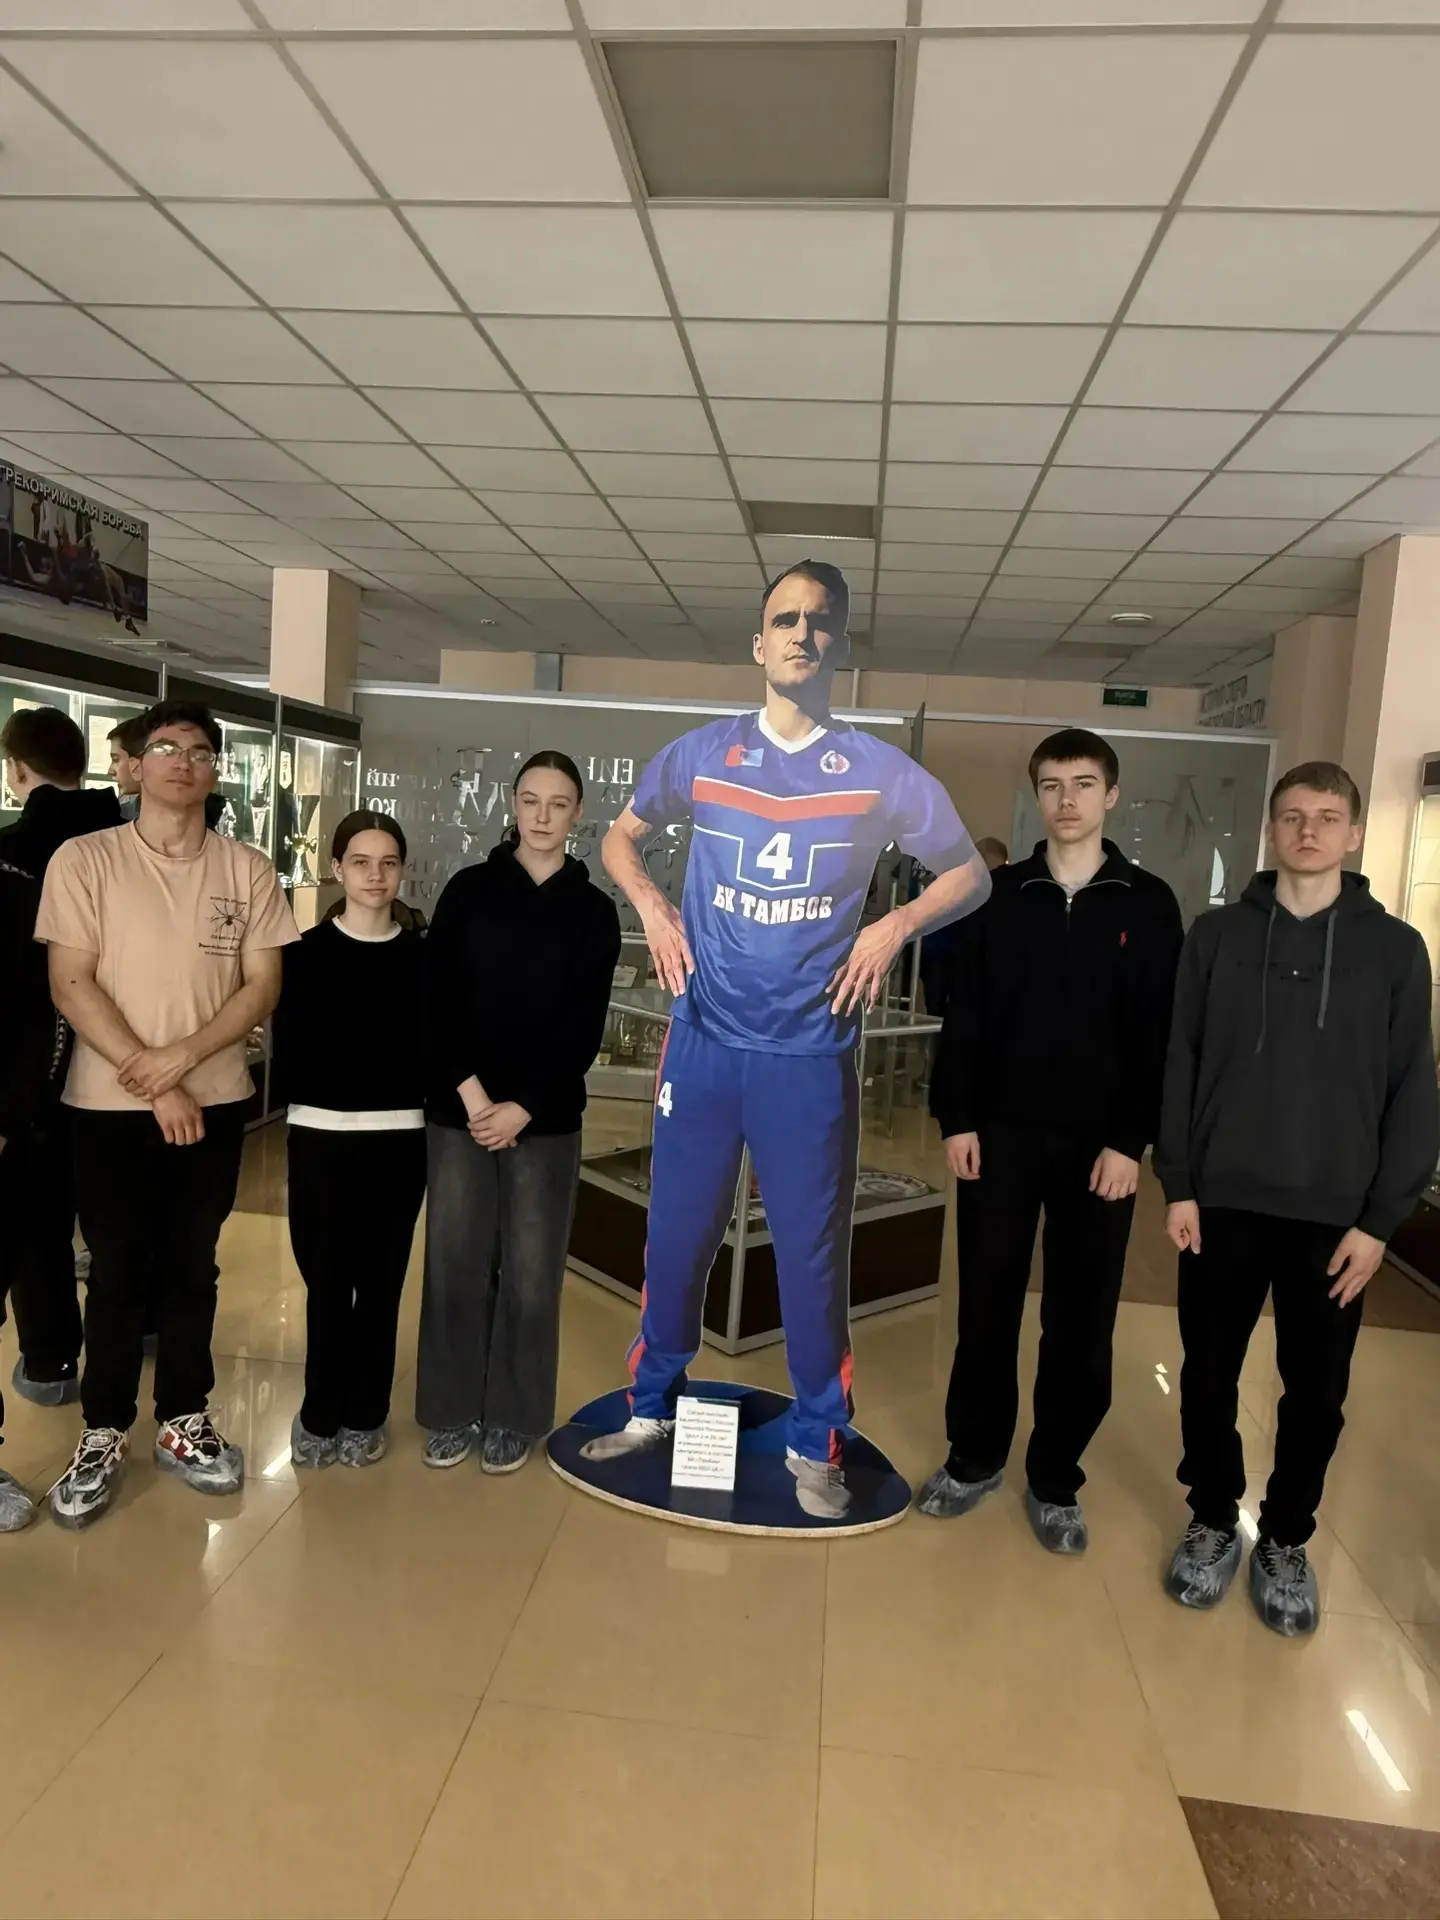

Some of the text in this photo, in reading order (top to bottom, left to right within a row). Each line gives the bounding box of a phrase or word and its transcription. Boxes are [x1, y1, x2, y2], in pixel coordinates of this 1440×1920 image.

[102, 510, 142, 535] БОРЬБА
[756, 832, 793, 880] 4
[713, 884, 832, 925] БК ТАМБОВ
[658, 1081, 673, 1118] 4
